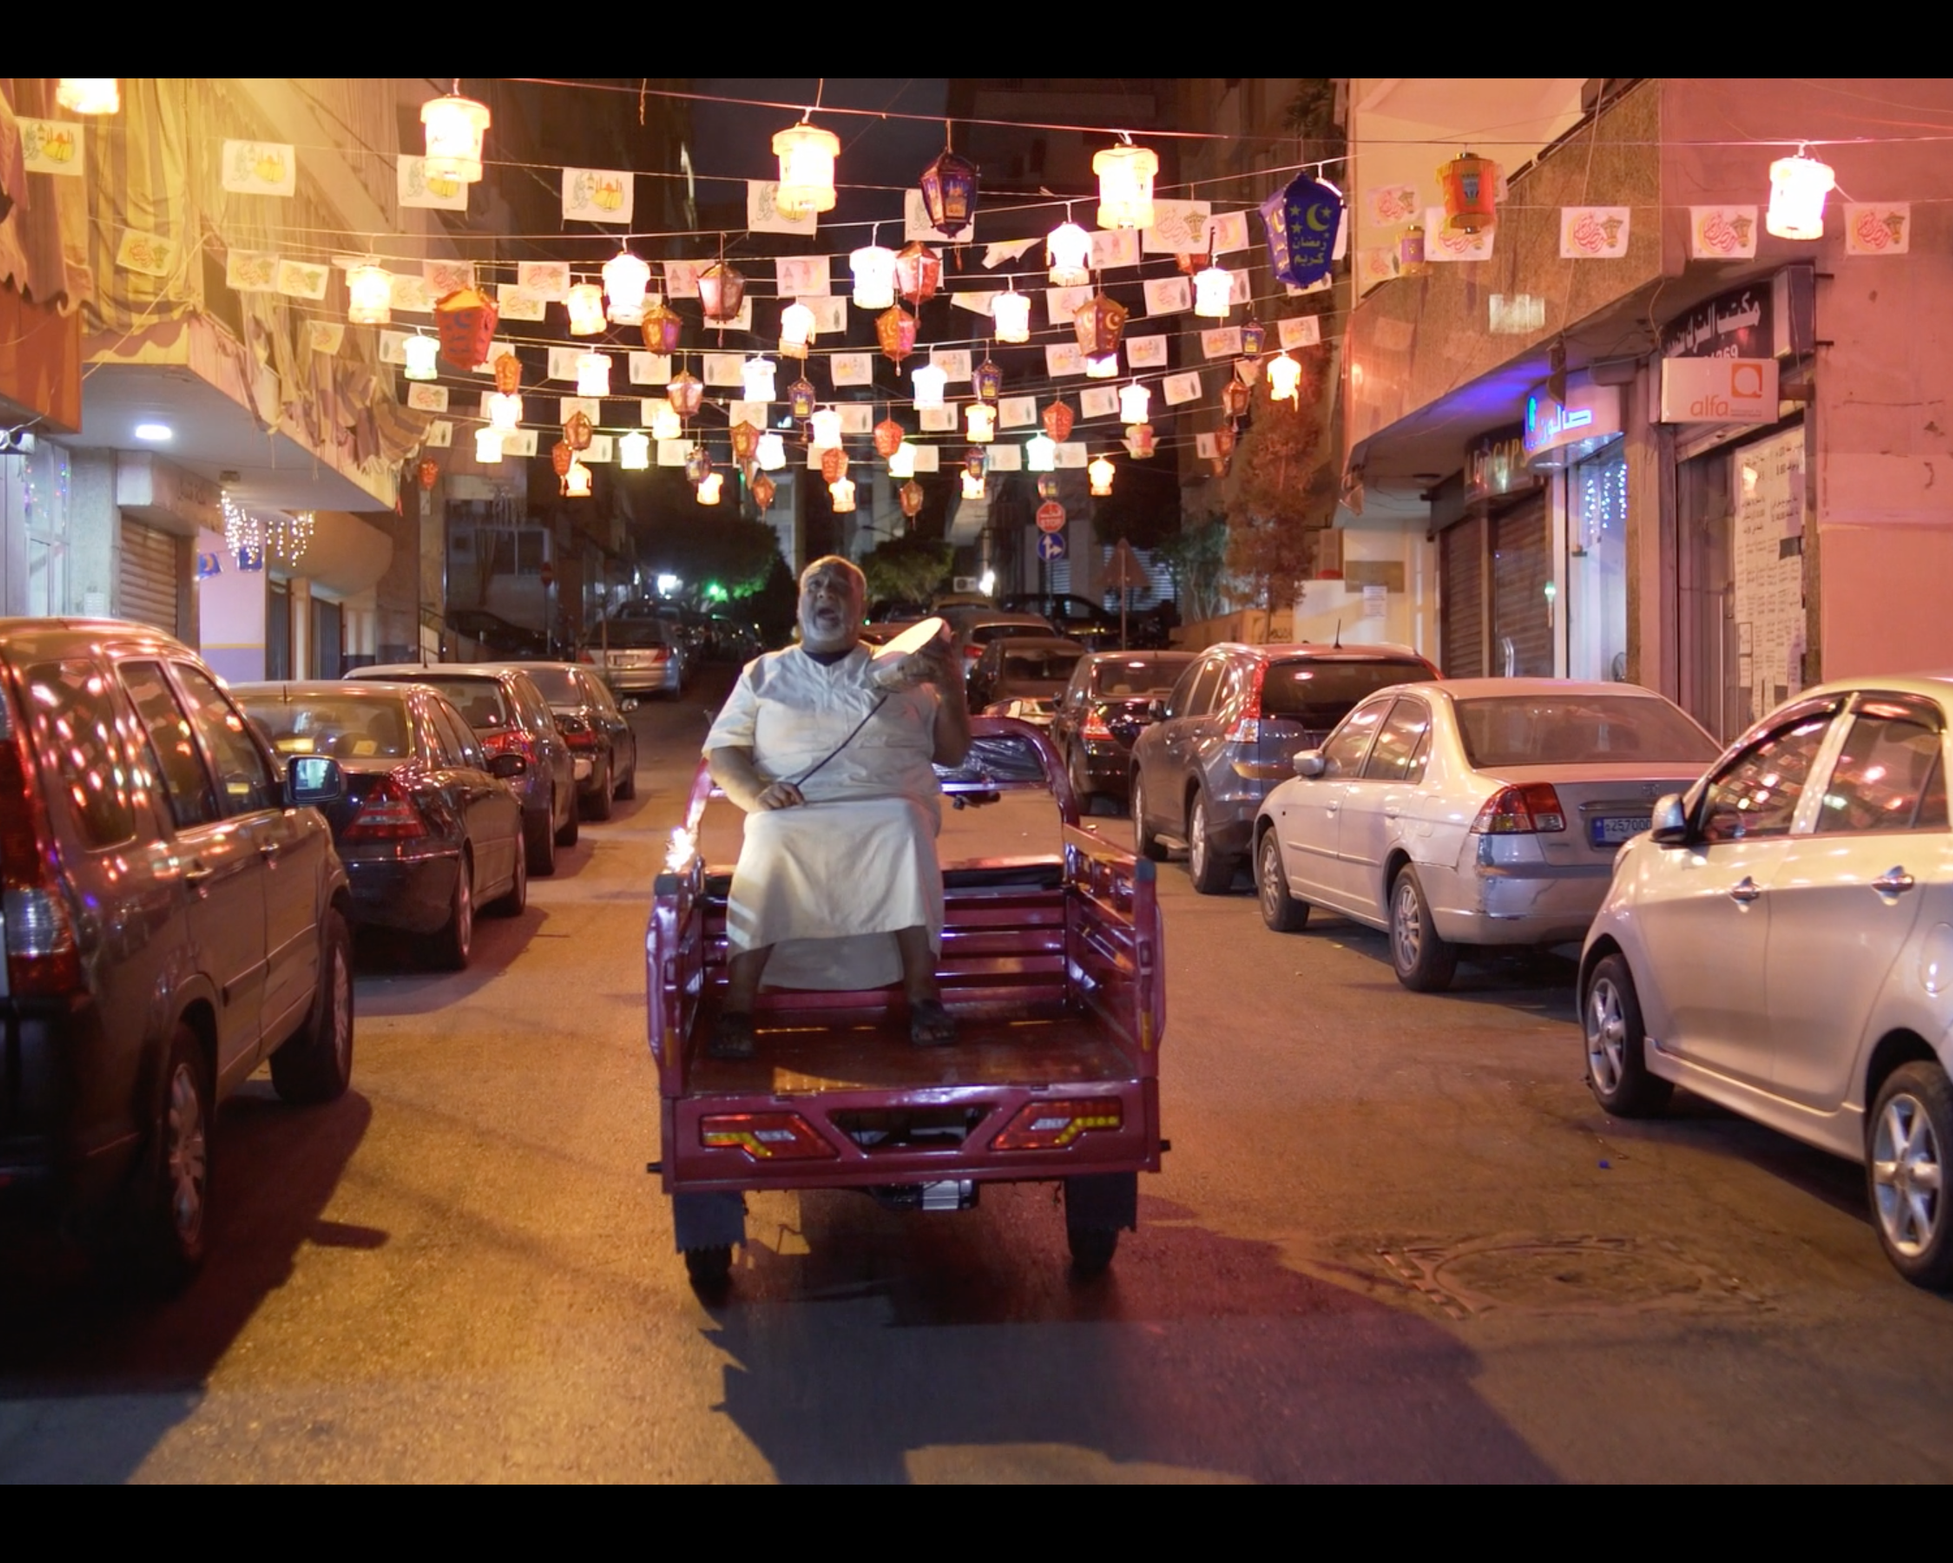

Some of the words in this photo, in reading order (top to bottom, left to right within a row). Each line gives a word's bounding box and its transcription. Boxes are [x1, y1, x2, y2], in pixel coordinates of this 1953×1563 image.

[1292, 235, 1327, 250] رمضان
[1294, 253, 1325, 266] كريم
[1717, 291, 1761, 341] مكتب
[1690, 395, 1729, 417] alfa
